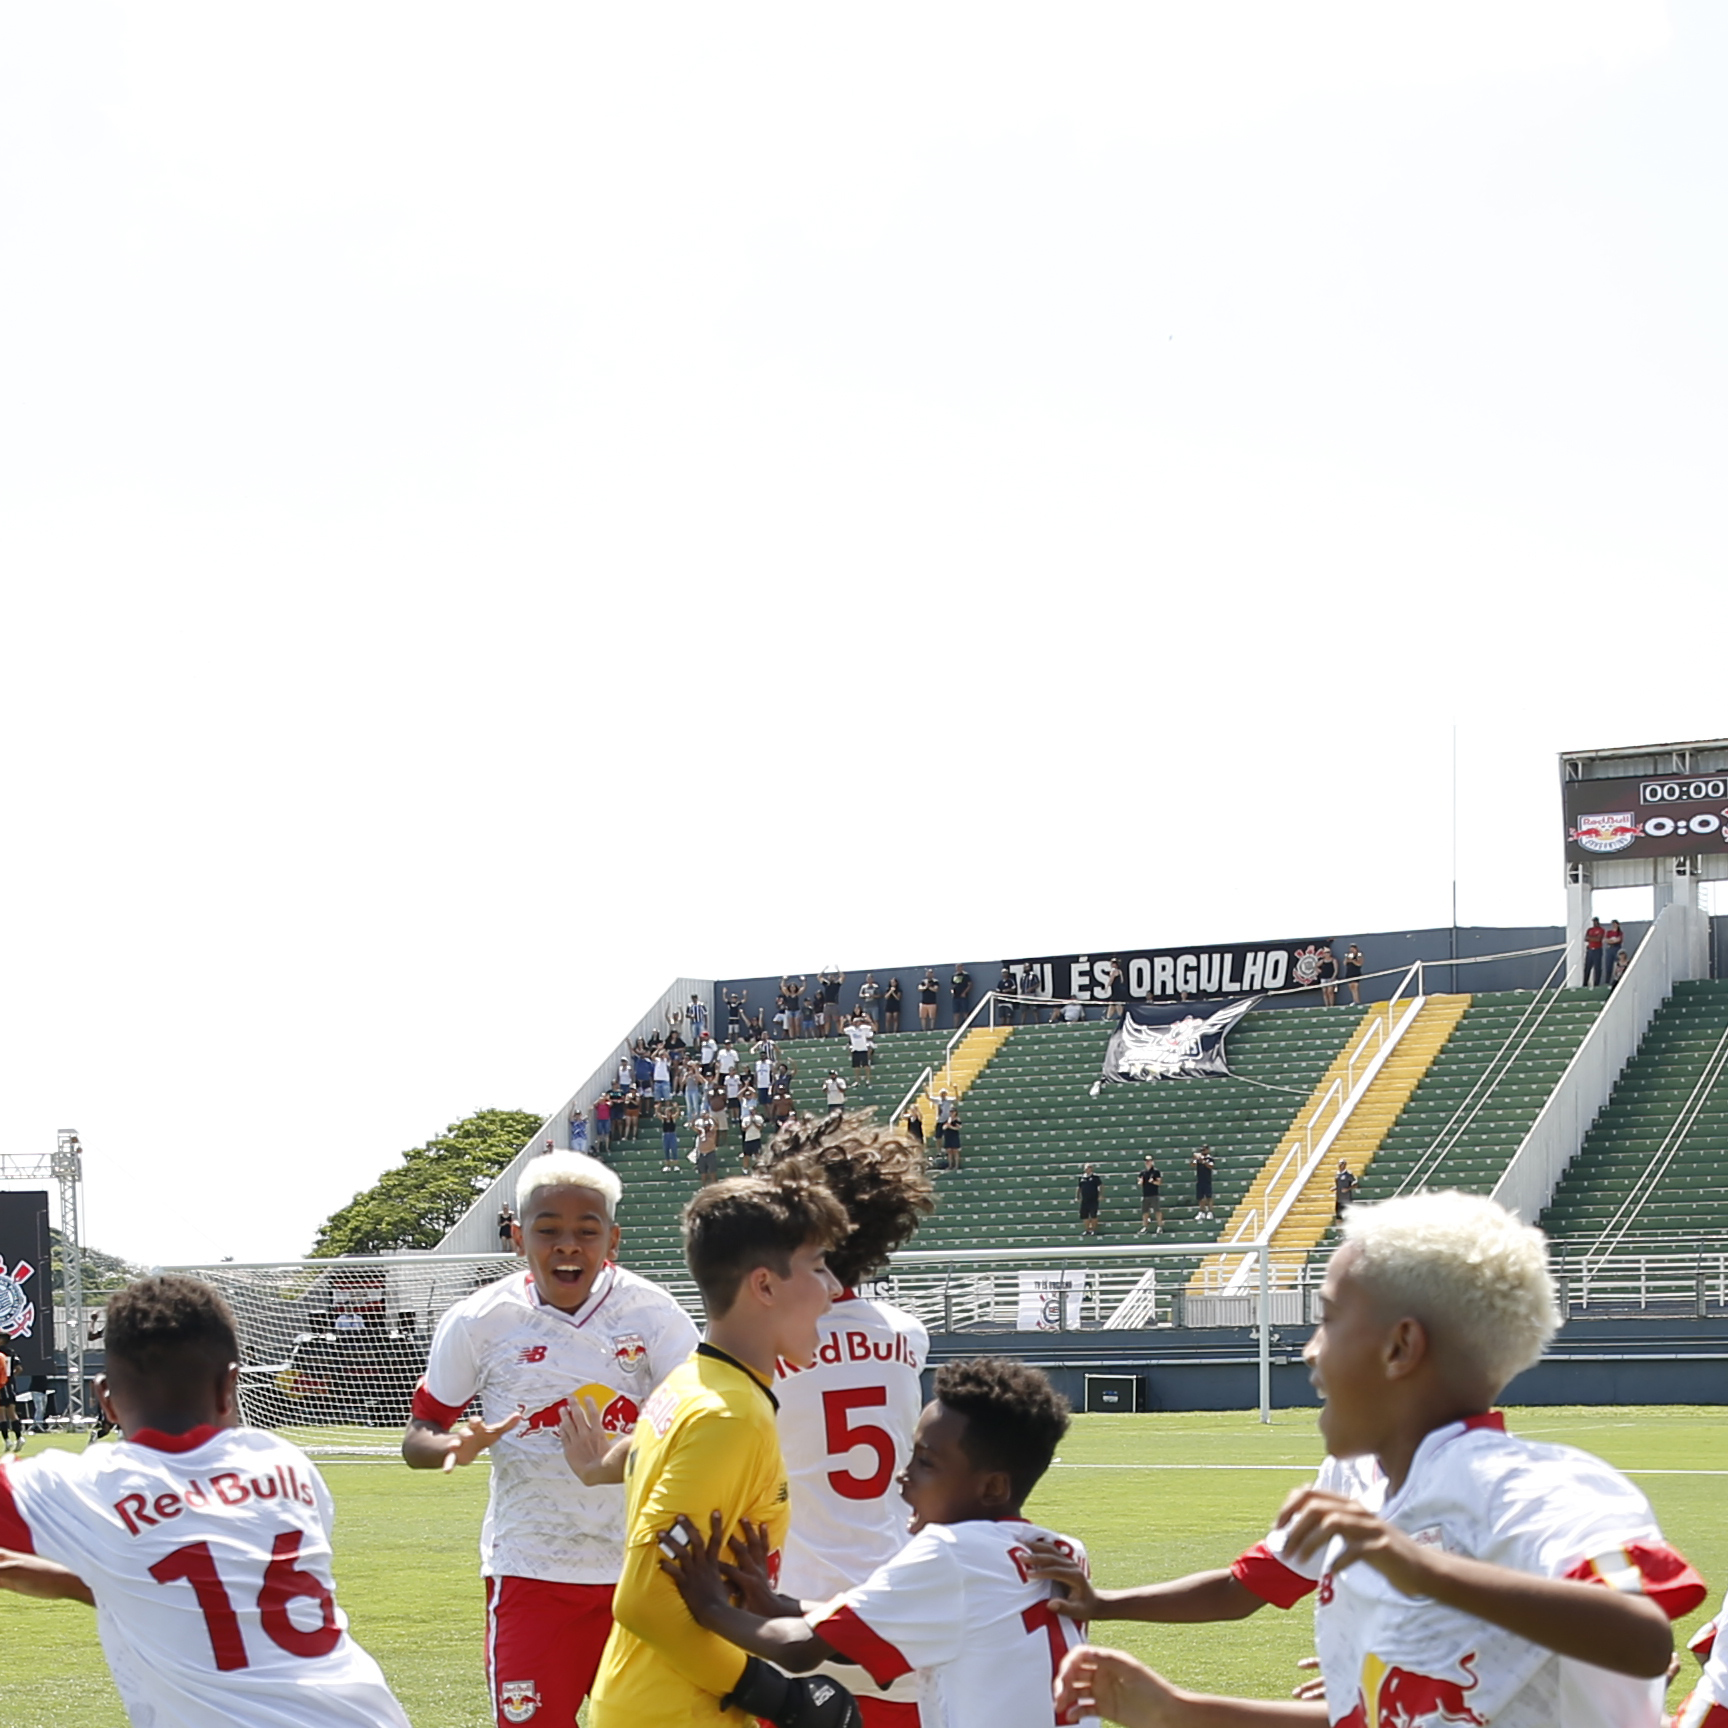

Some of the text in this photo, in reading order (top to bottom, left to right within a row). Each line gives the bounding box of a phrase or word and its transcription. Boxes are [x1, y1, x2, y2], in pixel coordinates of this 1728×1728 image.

[1644, 781, 1725, 802] 00:00
[1643, 813, 1720, 836] 0:0
[1070, 957, 1114, 1000] ÉS
[1128, 950, 1289, 998] ORGULHO
[821, 1385, 896, 1501] 5
[147, 1530, 342, 1672] 16
